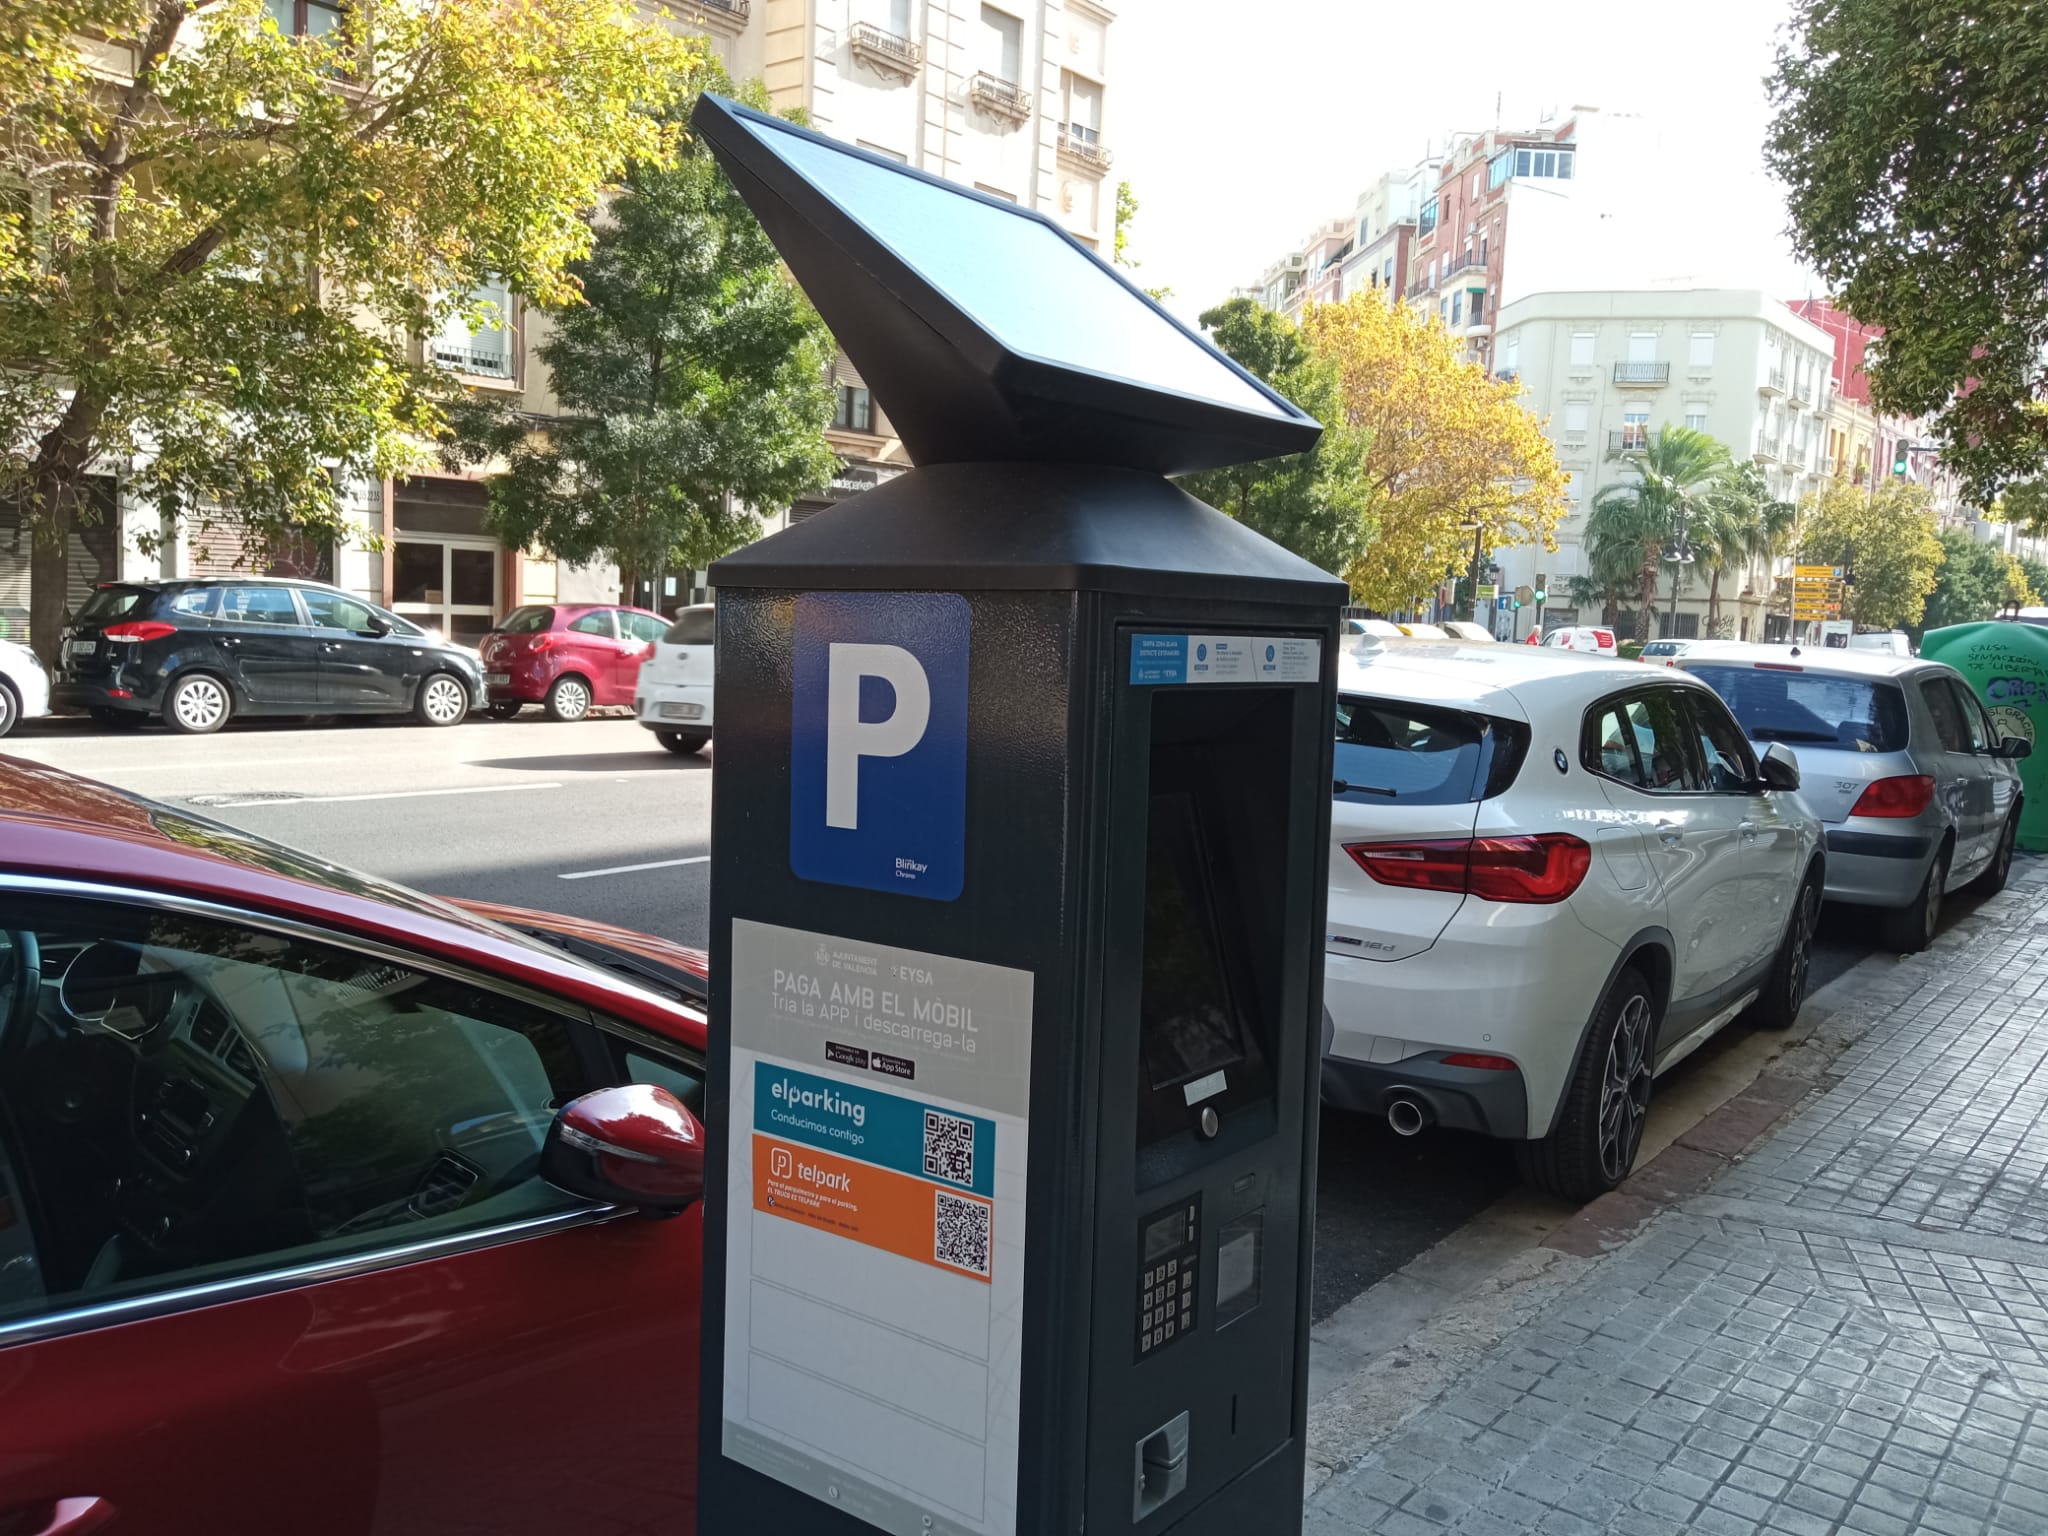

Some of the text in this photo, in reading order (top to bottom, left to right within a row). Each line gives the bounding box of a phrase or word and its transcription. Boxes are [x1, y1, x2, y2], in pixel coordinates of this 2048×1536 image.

[826, 642, 931, 830] P
[1833, 781, 1859, 791] 307
[895, 857, 928, 874] Blinkay
[774, 968, 821, 999] PAGA
[830, 981, 874, 1009] AMB
[882, 991, 905, 1017] EL
[772, 991, 797, 1013] Tria
[802, 999, 814, 1017] la
[819, 1003, 850, 1024] APP
[863, 1013, 976, 1053] descarrega-la
[881, 1062, 911, 1075] App Store
[771, 1078, 865, 1127] elparking
[771, 1109, 865, 1145] Conducimos contigo
[797, 1162, 851, 1193] telpark
